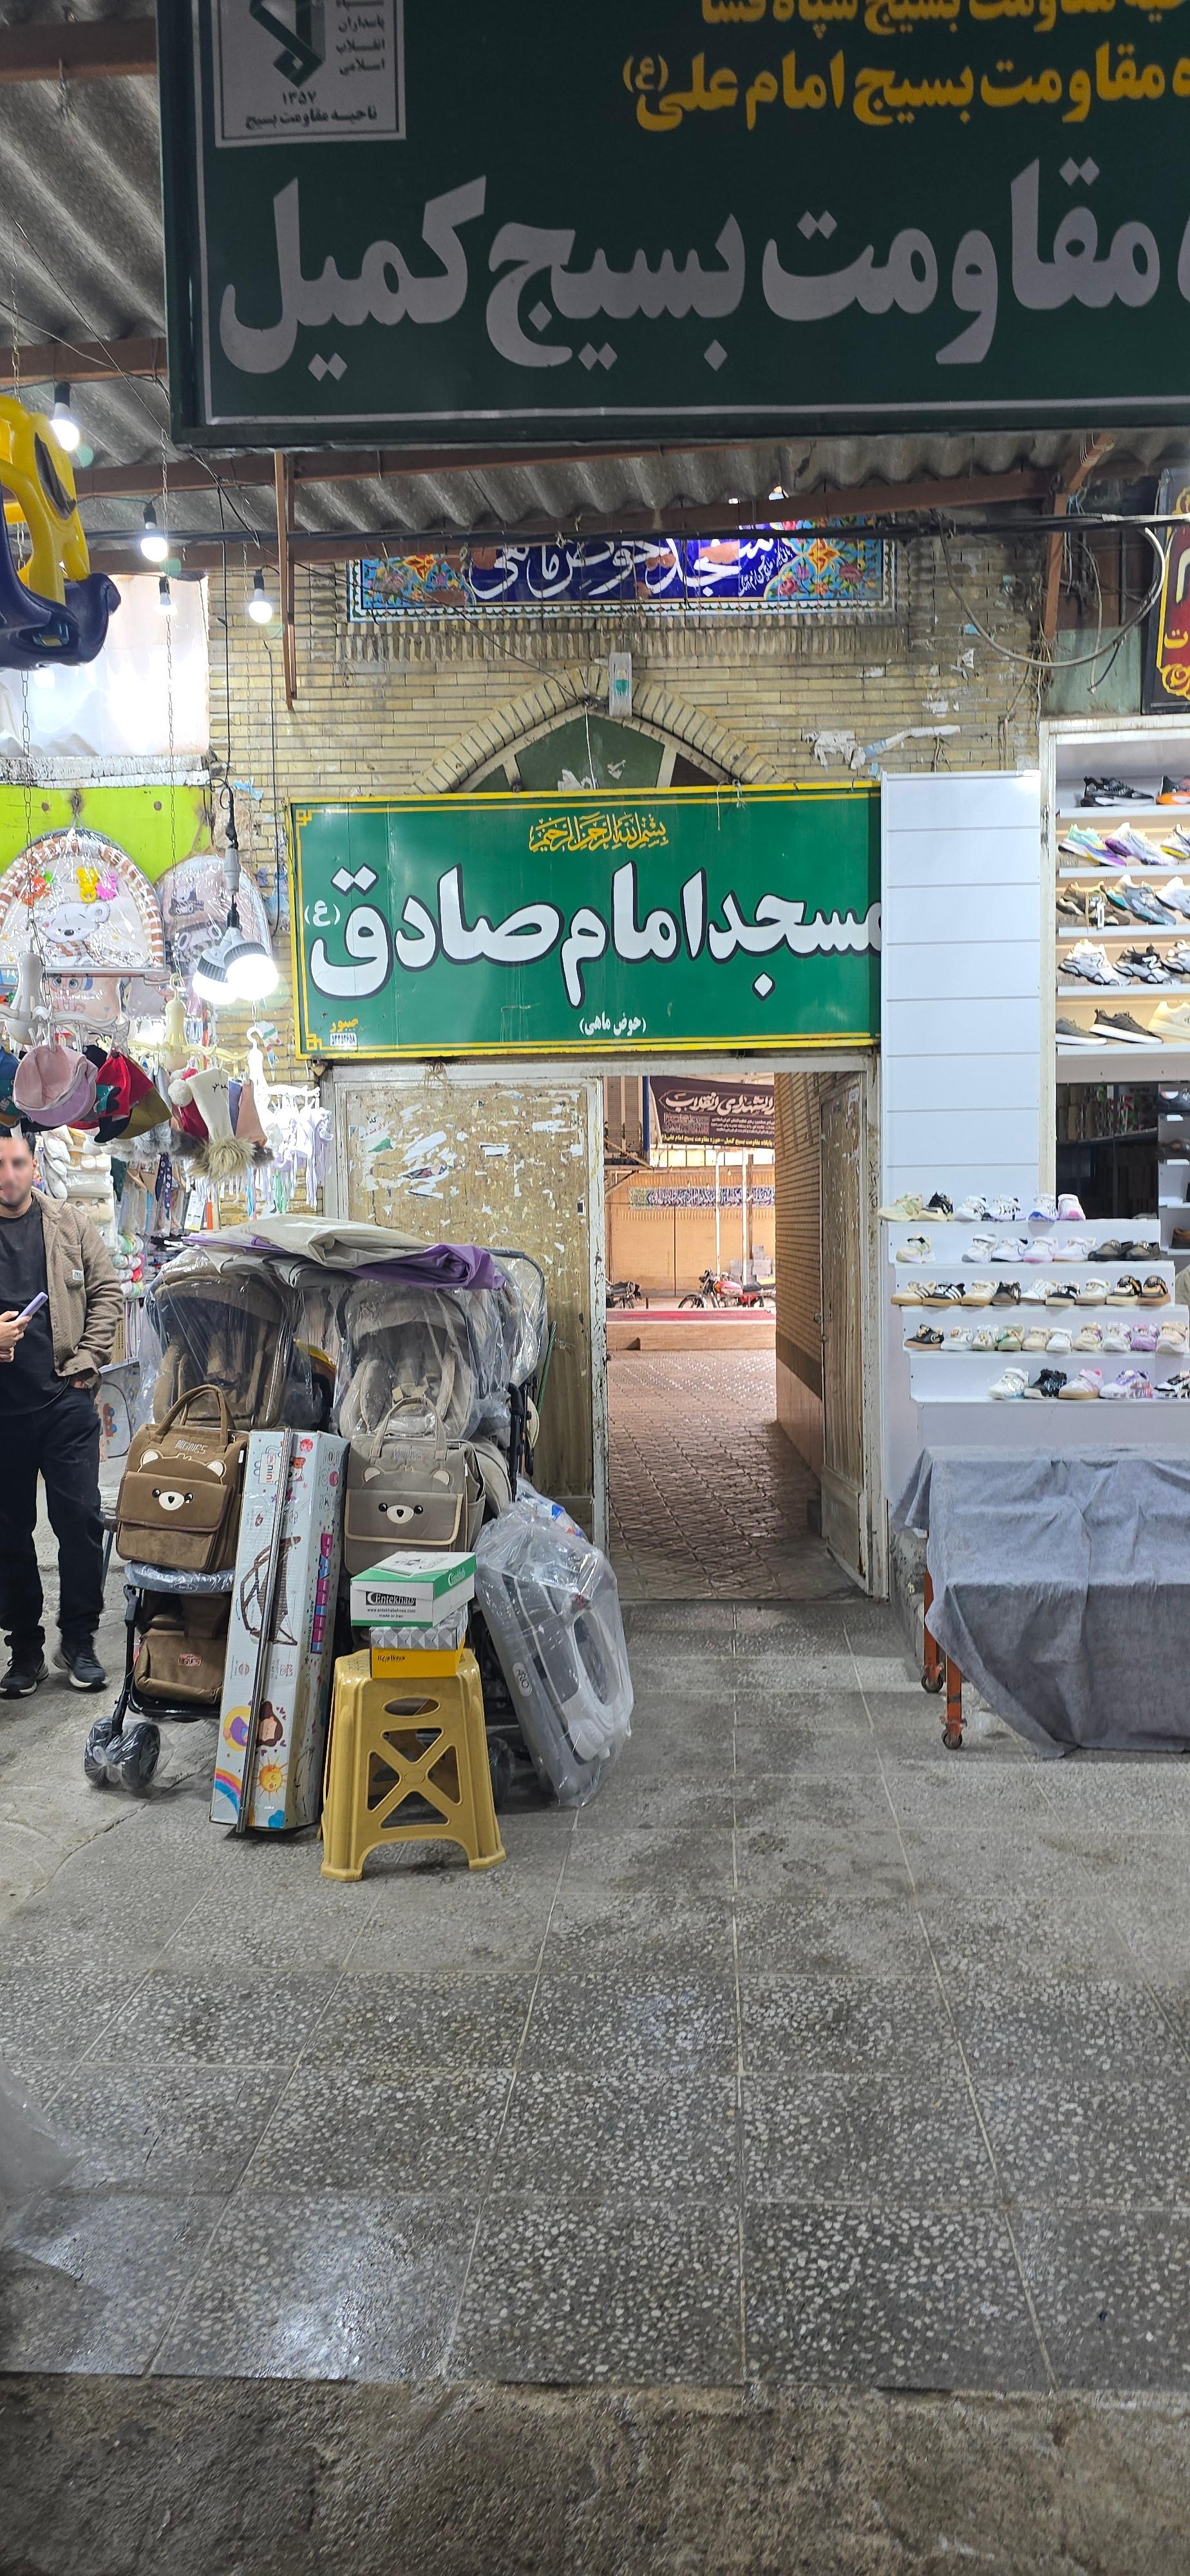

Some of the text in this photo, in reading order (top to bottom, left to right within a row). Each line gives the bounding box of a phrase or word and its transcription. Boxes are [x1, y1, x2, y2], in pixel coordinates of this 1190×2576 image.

[279, 108, 328, 128] مقاومت
[283, 90, 316, 105] ۱۳۵۷
[636, 52, 739, 132] علی
[745, 49, 845, 131] امام
[853, 66, 974, 126] بسیج
[981, 41, 1166, 124] مقاومت
[220, 175, 487, 382] کمیل
[486, 213, 746, 372] بسیج
[762, 156, 1160, 366] مقاومت
[304, 899, 341, 926] (ع)
[310, 865, 564, 998] صادق
[562, 861, 706, 1007] امام
[579, 1010, 647, 1036] (حوض ماهی)
